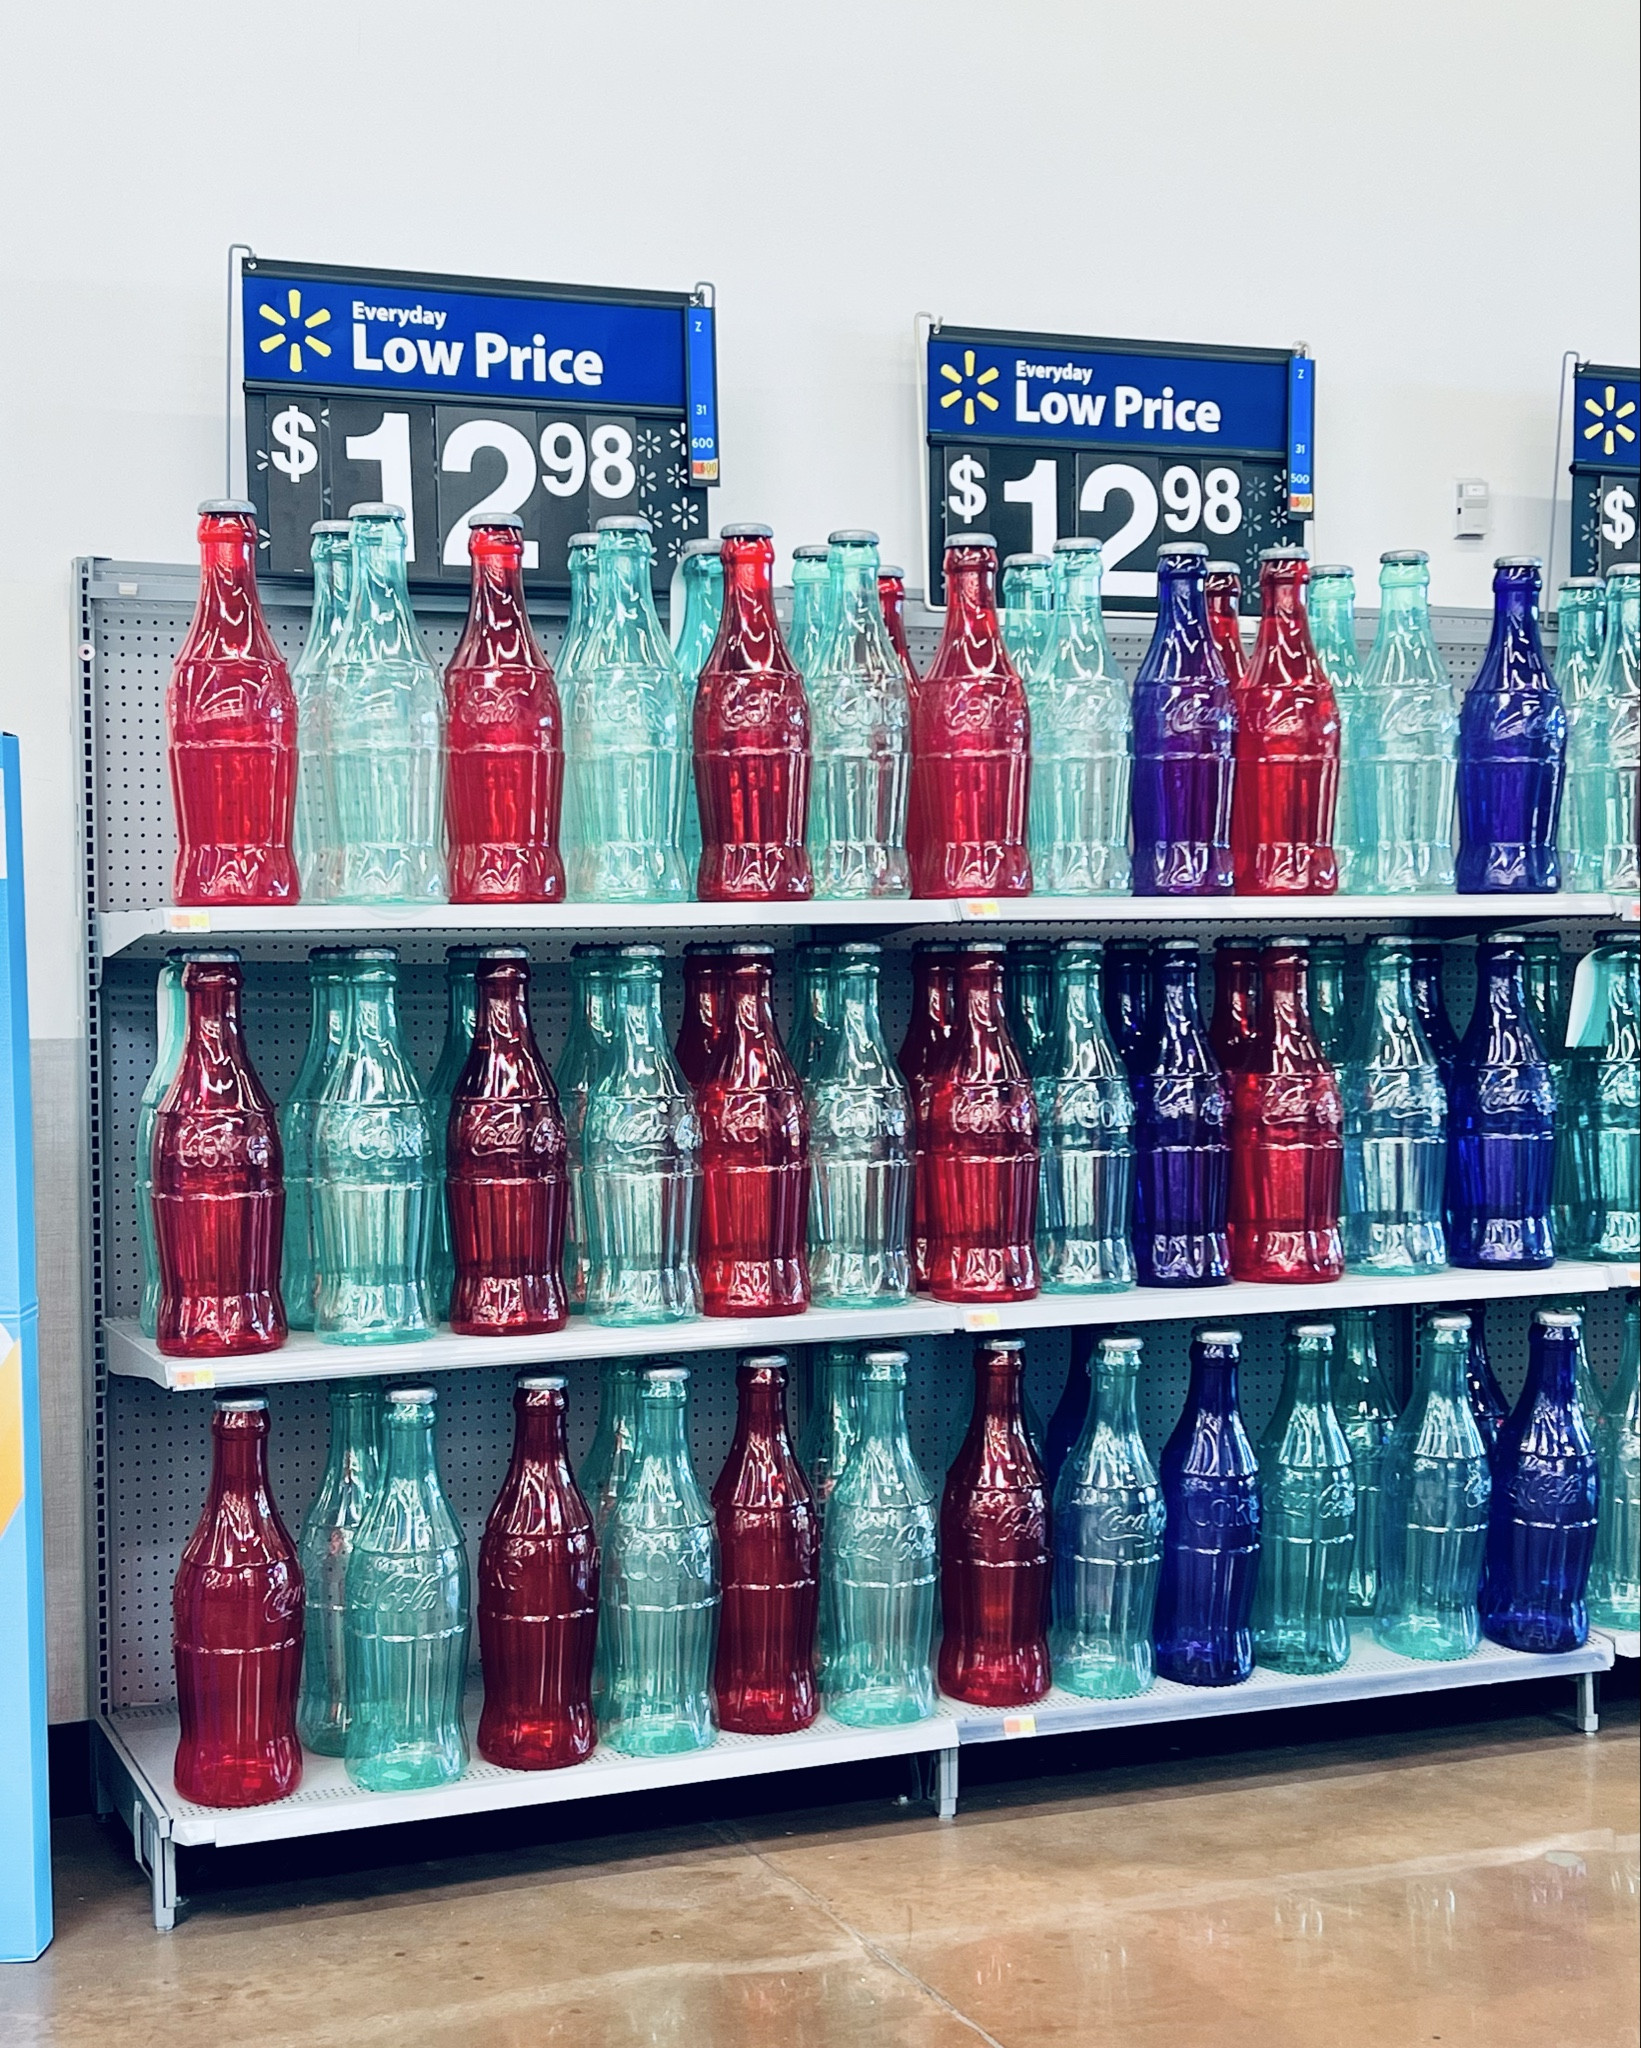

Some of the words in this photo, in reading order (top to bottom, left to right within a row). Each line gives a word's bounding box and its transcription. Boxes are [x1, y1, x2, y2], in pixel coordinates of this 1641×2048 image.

[352, 301, 447, 330] Everyday
[353, 323, 464, 376] Low
[475, 332, 603, 386] Price
[1016, 360, 1093, 386] Everyday
[695, 404, 707, 415] 31
[1016, 379, 1107, 427] Low
[1115, 386, 1221, 433] Price
[691, 437, 714, 449] 600
[1295, 444, 1306, 454] 31
[1290, 473, 1310, 484] 500
[1601, 485, 1636, 550] $
